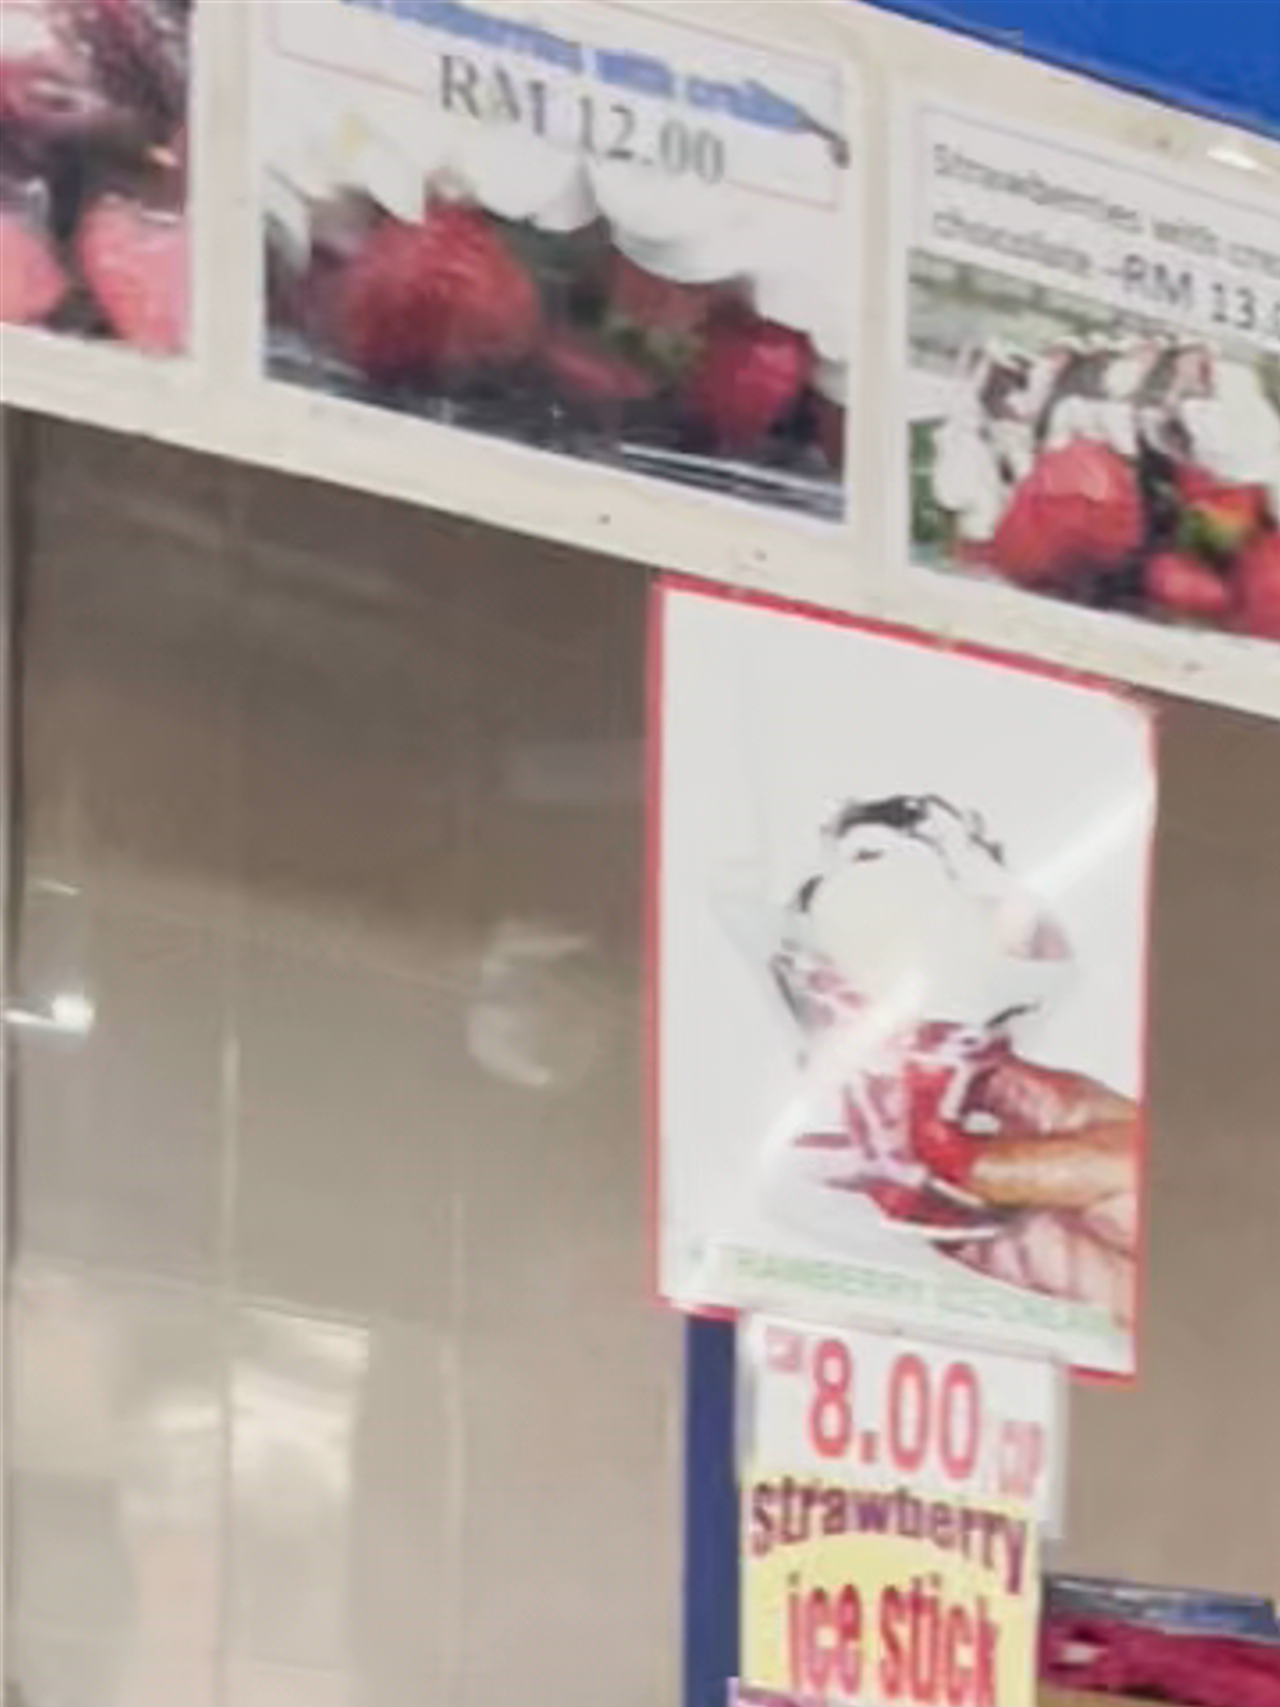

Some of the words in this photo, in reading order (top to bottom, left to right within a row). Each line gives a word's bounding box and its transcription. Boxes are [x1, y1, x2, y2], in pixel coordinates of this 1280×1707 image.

[438, 52, 547, 138] RM
[577, 94, 728, 186] 12.00
[808, 1337, 982, 1482] 8.00
[750, 1475, 1030, 1596] strawberry
[786, 1570, 863, 1696] ice
